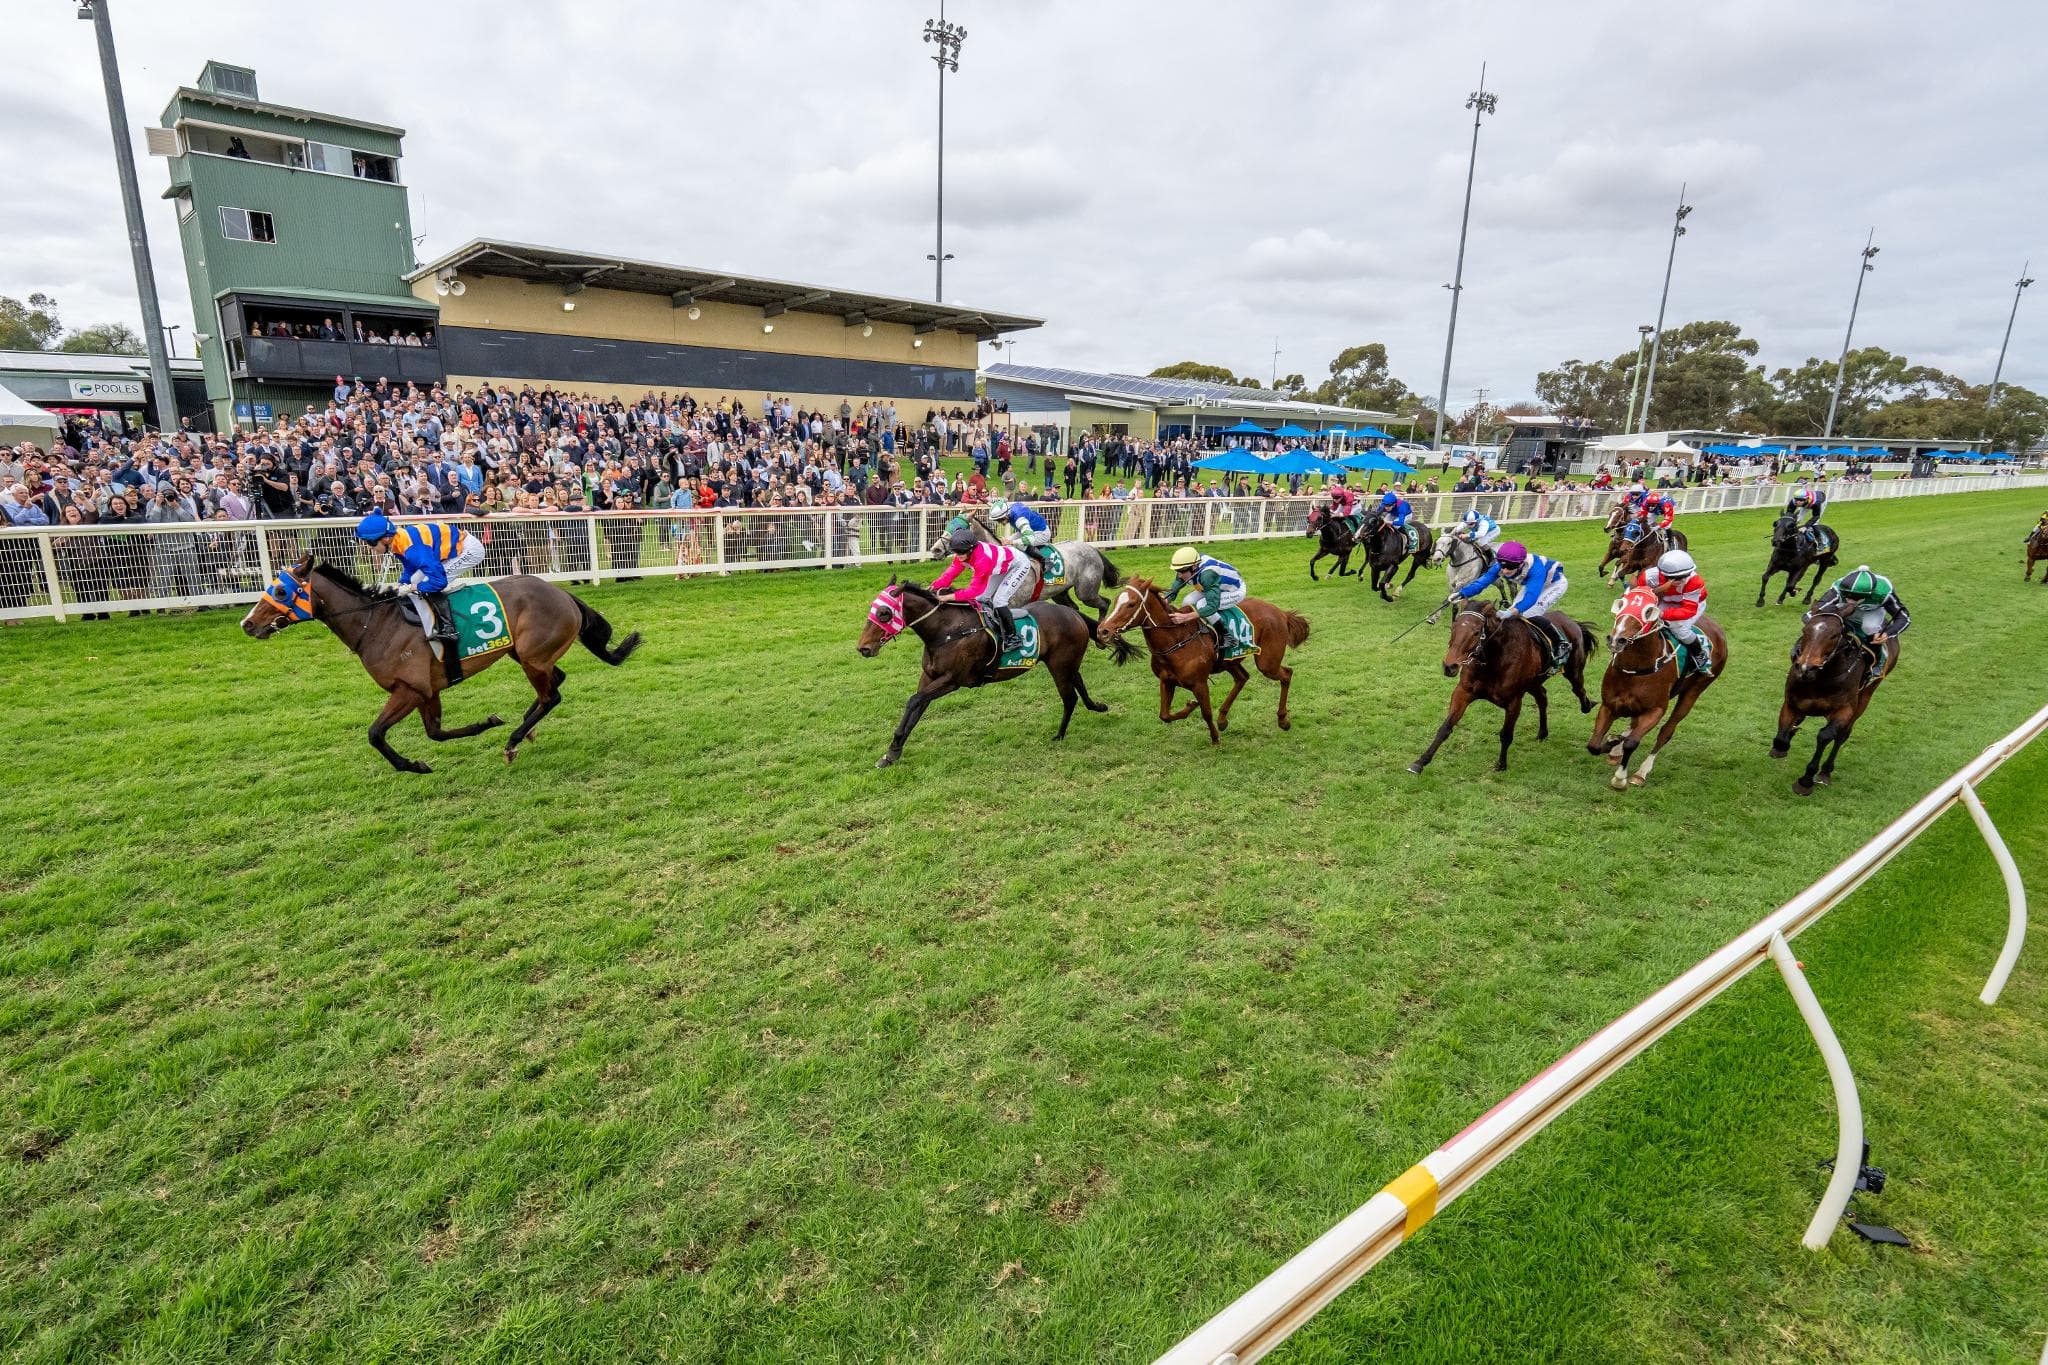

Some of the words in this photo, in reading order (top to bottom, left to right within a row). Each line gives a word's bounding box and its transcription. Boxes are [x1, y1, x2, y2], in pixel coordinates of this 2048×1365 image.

[94, 383, 139, 394] POOLES
[470, 601, 503, 640] 3
[1228, 617, 1254, 646] 14
[466, 635, 511, 656] bet365
[1020, 624, 1038, 657] 9
